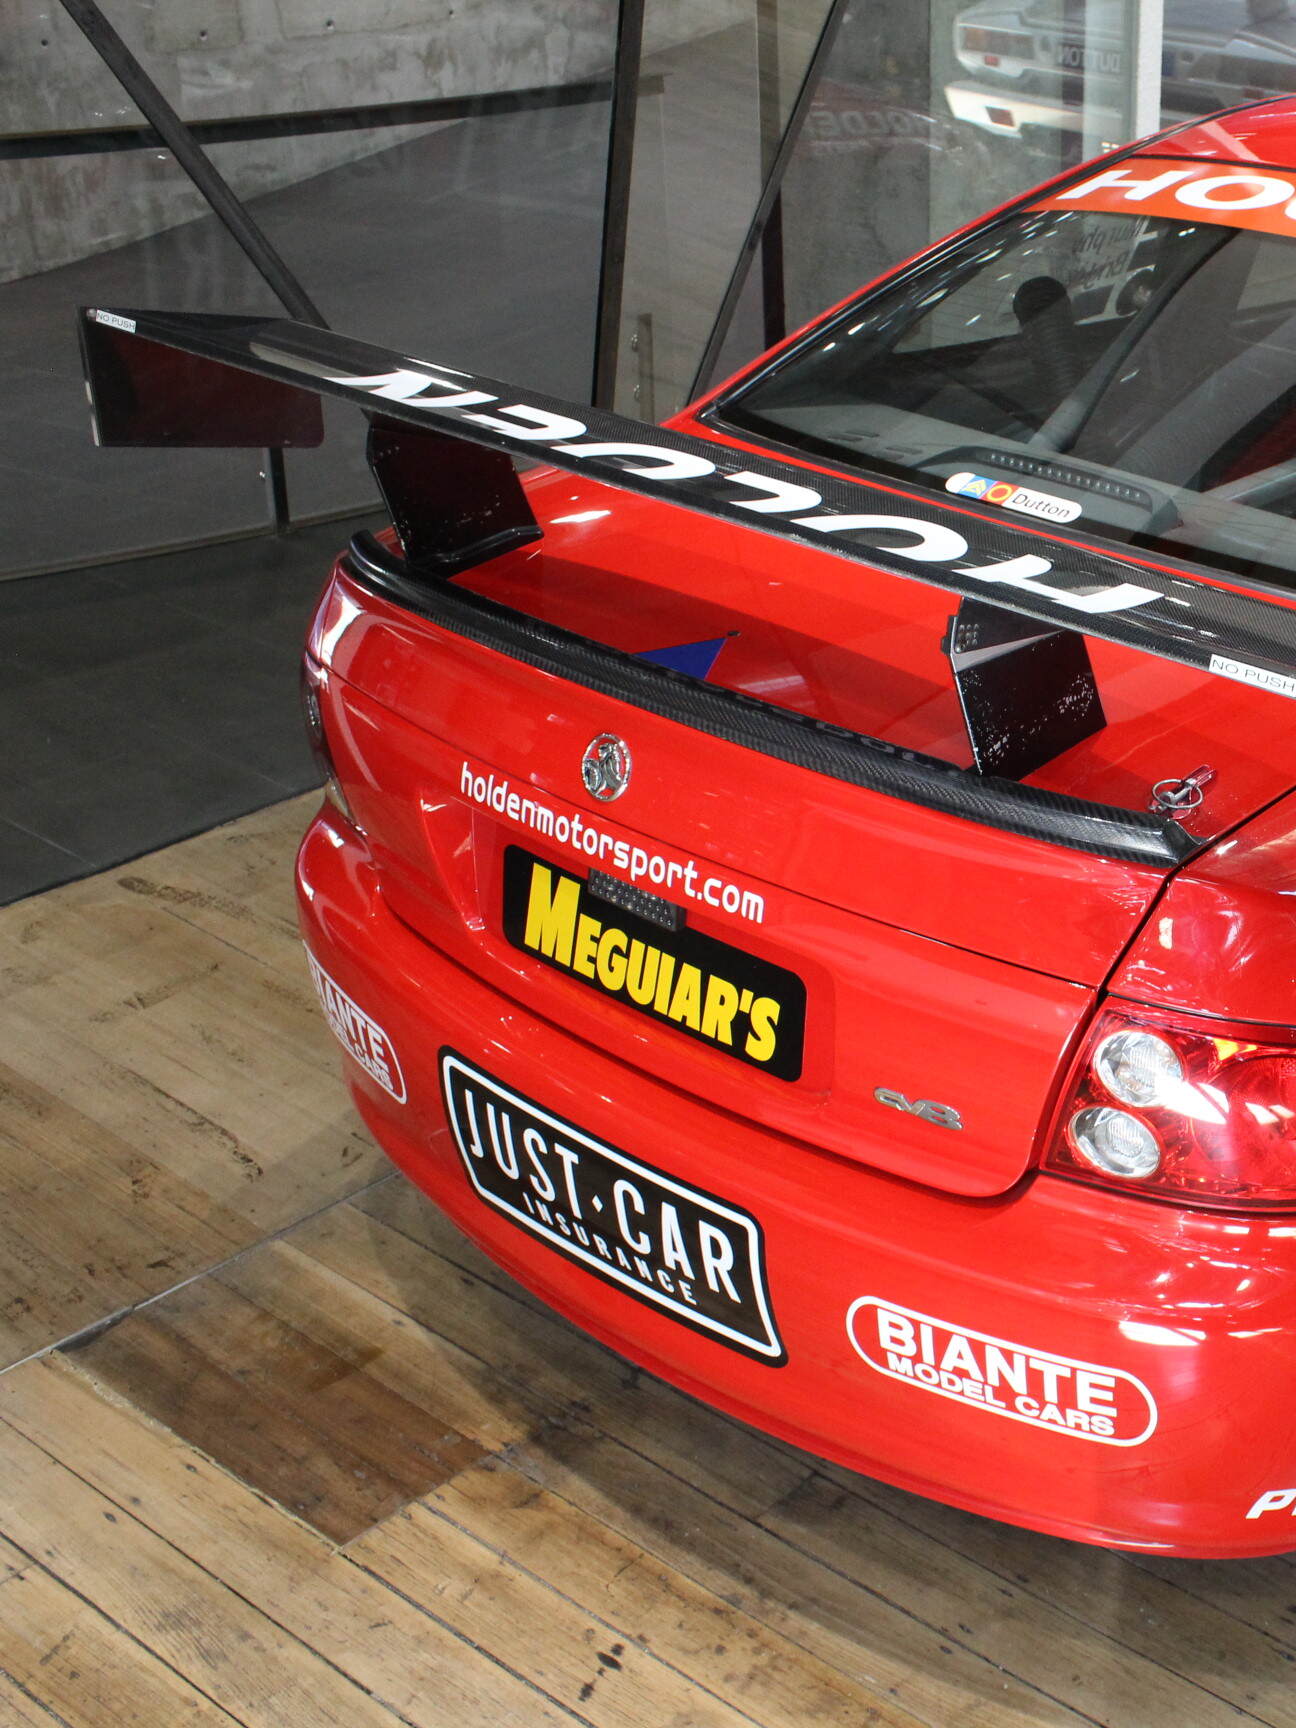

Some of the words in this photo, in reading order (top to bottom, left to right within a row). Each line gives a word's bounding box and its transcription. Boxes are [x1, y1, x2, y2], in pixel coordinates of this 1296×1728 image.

[1012, 493, 1071, 519] Dutton
[1212, 658, 1240, 675] NO
[1243, 668, 1296, 692] PUSH
[460, 761, 765, 924] holdenmotorsport.com
[464, 1088, 583, 1221] JUST
[612, 1178, 743, 1305] CAR
[522, 1191, 698, 1306] INSURANCE
[876, 1307, 1119, 1419] BIANTE
[886, 1350, 1007, 1409] MODEL
[1013, 1395, 1116, 1437] CARS
